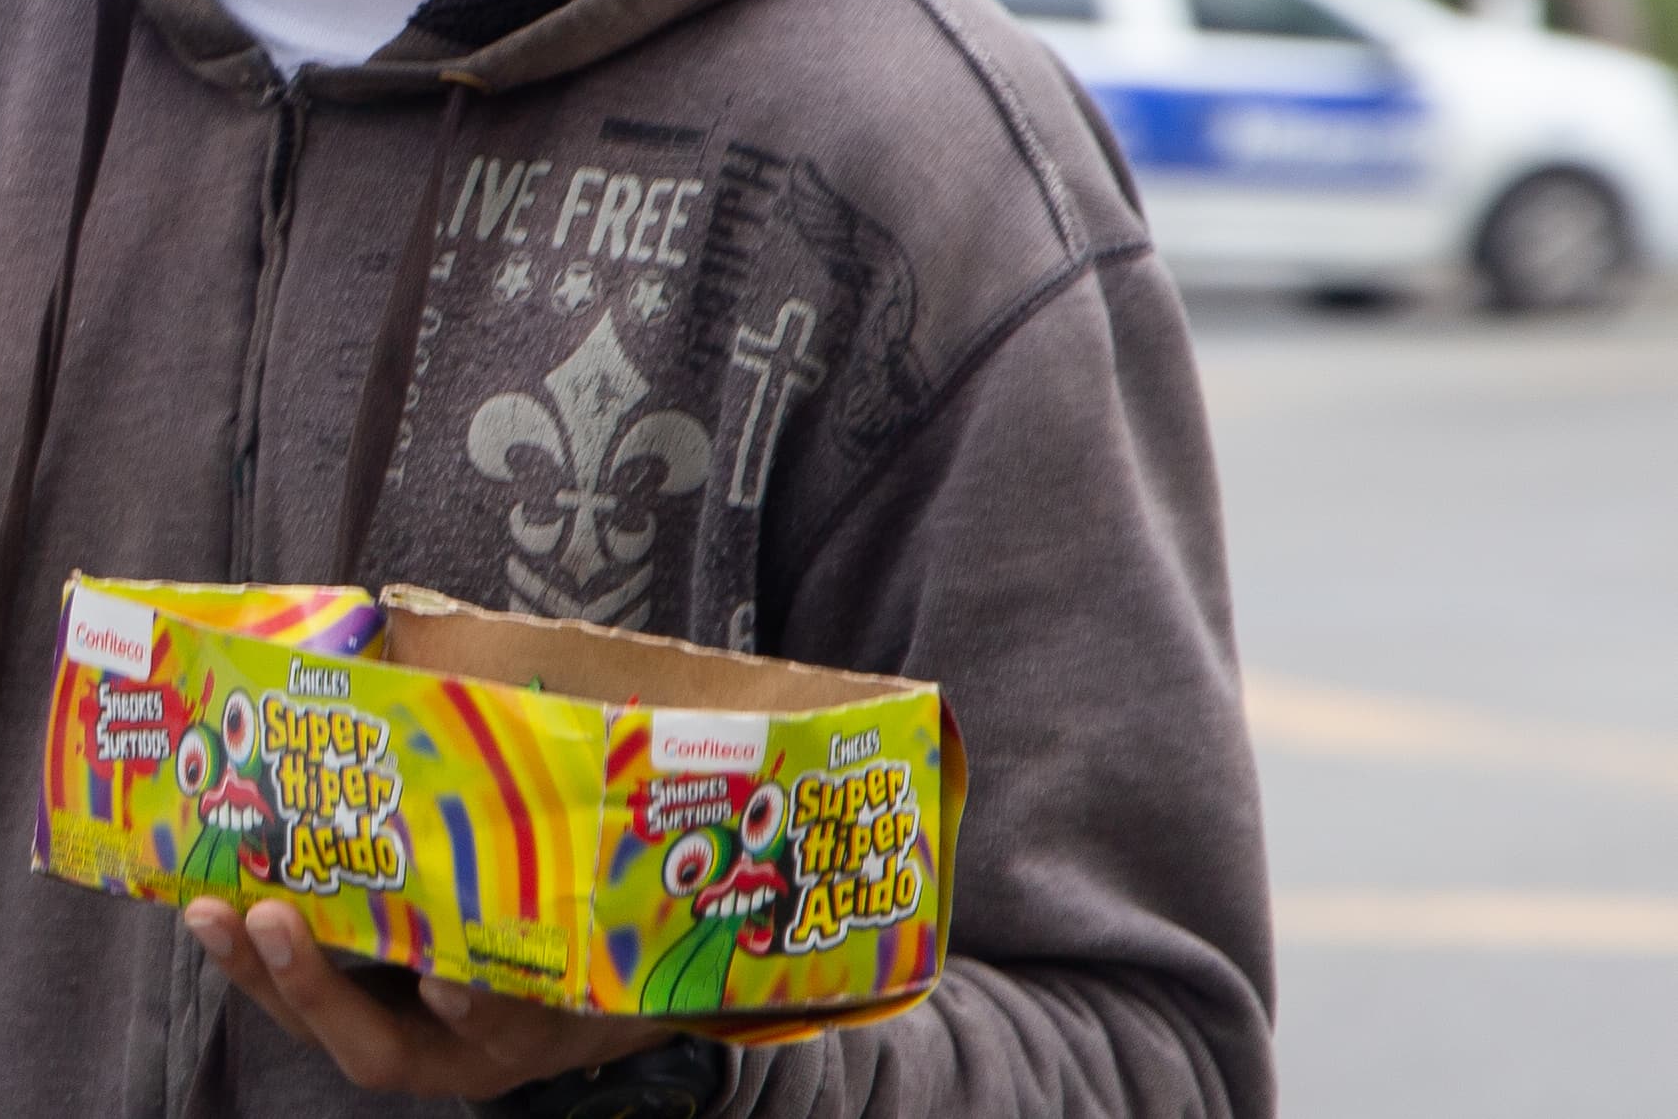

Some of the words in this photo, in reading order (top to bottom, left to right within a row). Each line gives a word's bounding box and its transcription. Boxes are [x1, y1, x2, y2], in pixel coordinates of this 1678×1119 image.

[436, 154, 552, 246] IVE
[552, 166, 703, 270] FREE
[76, 620, 145, 665] Confiteca
[262, 694, 384, 765] Super
[664, 737, 756, 761] Confiteca
[278, 751, 398, 819] Hiper
[793, 765, 906, 831] Super
[802, 808, 916, 875] Hiper
